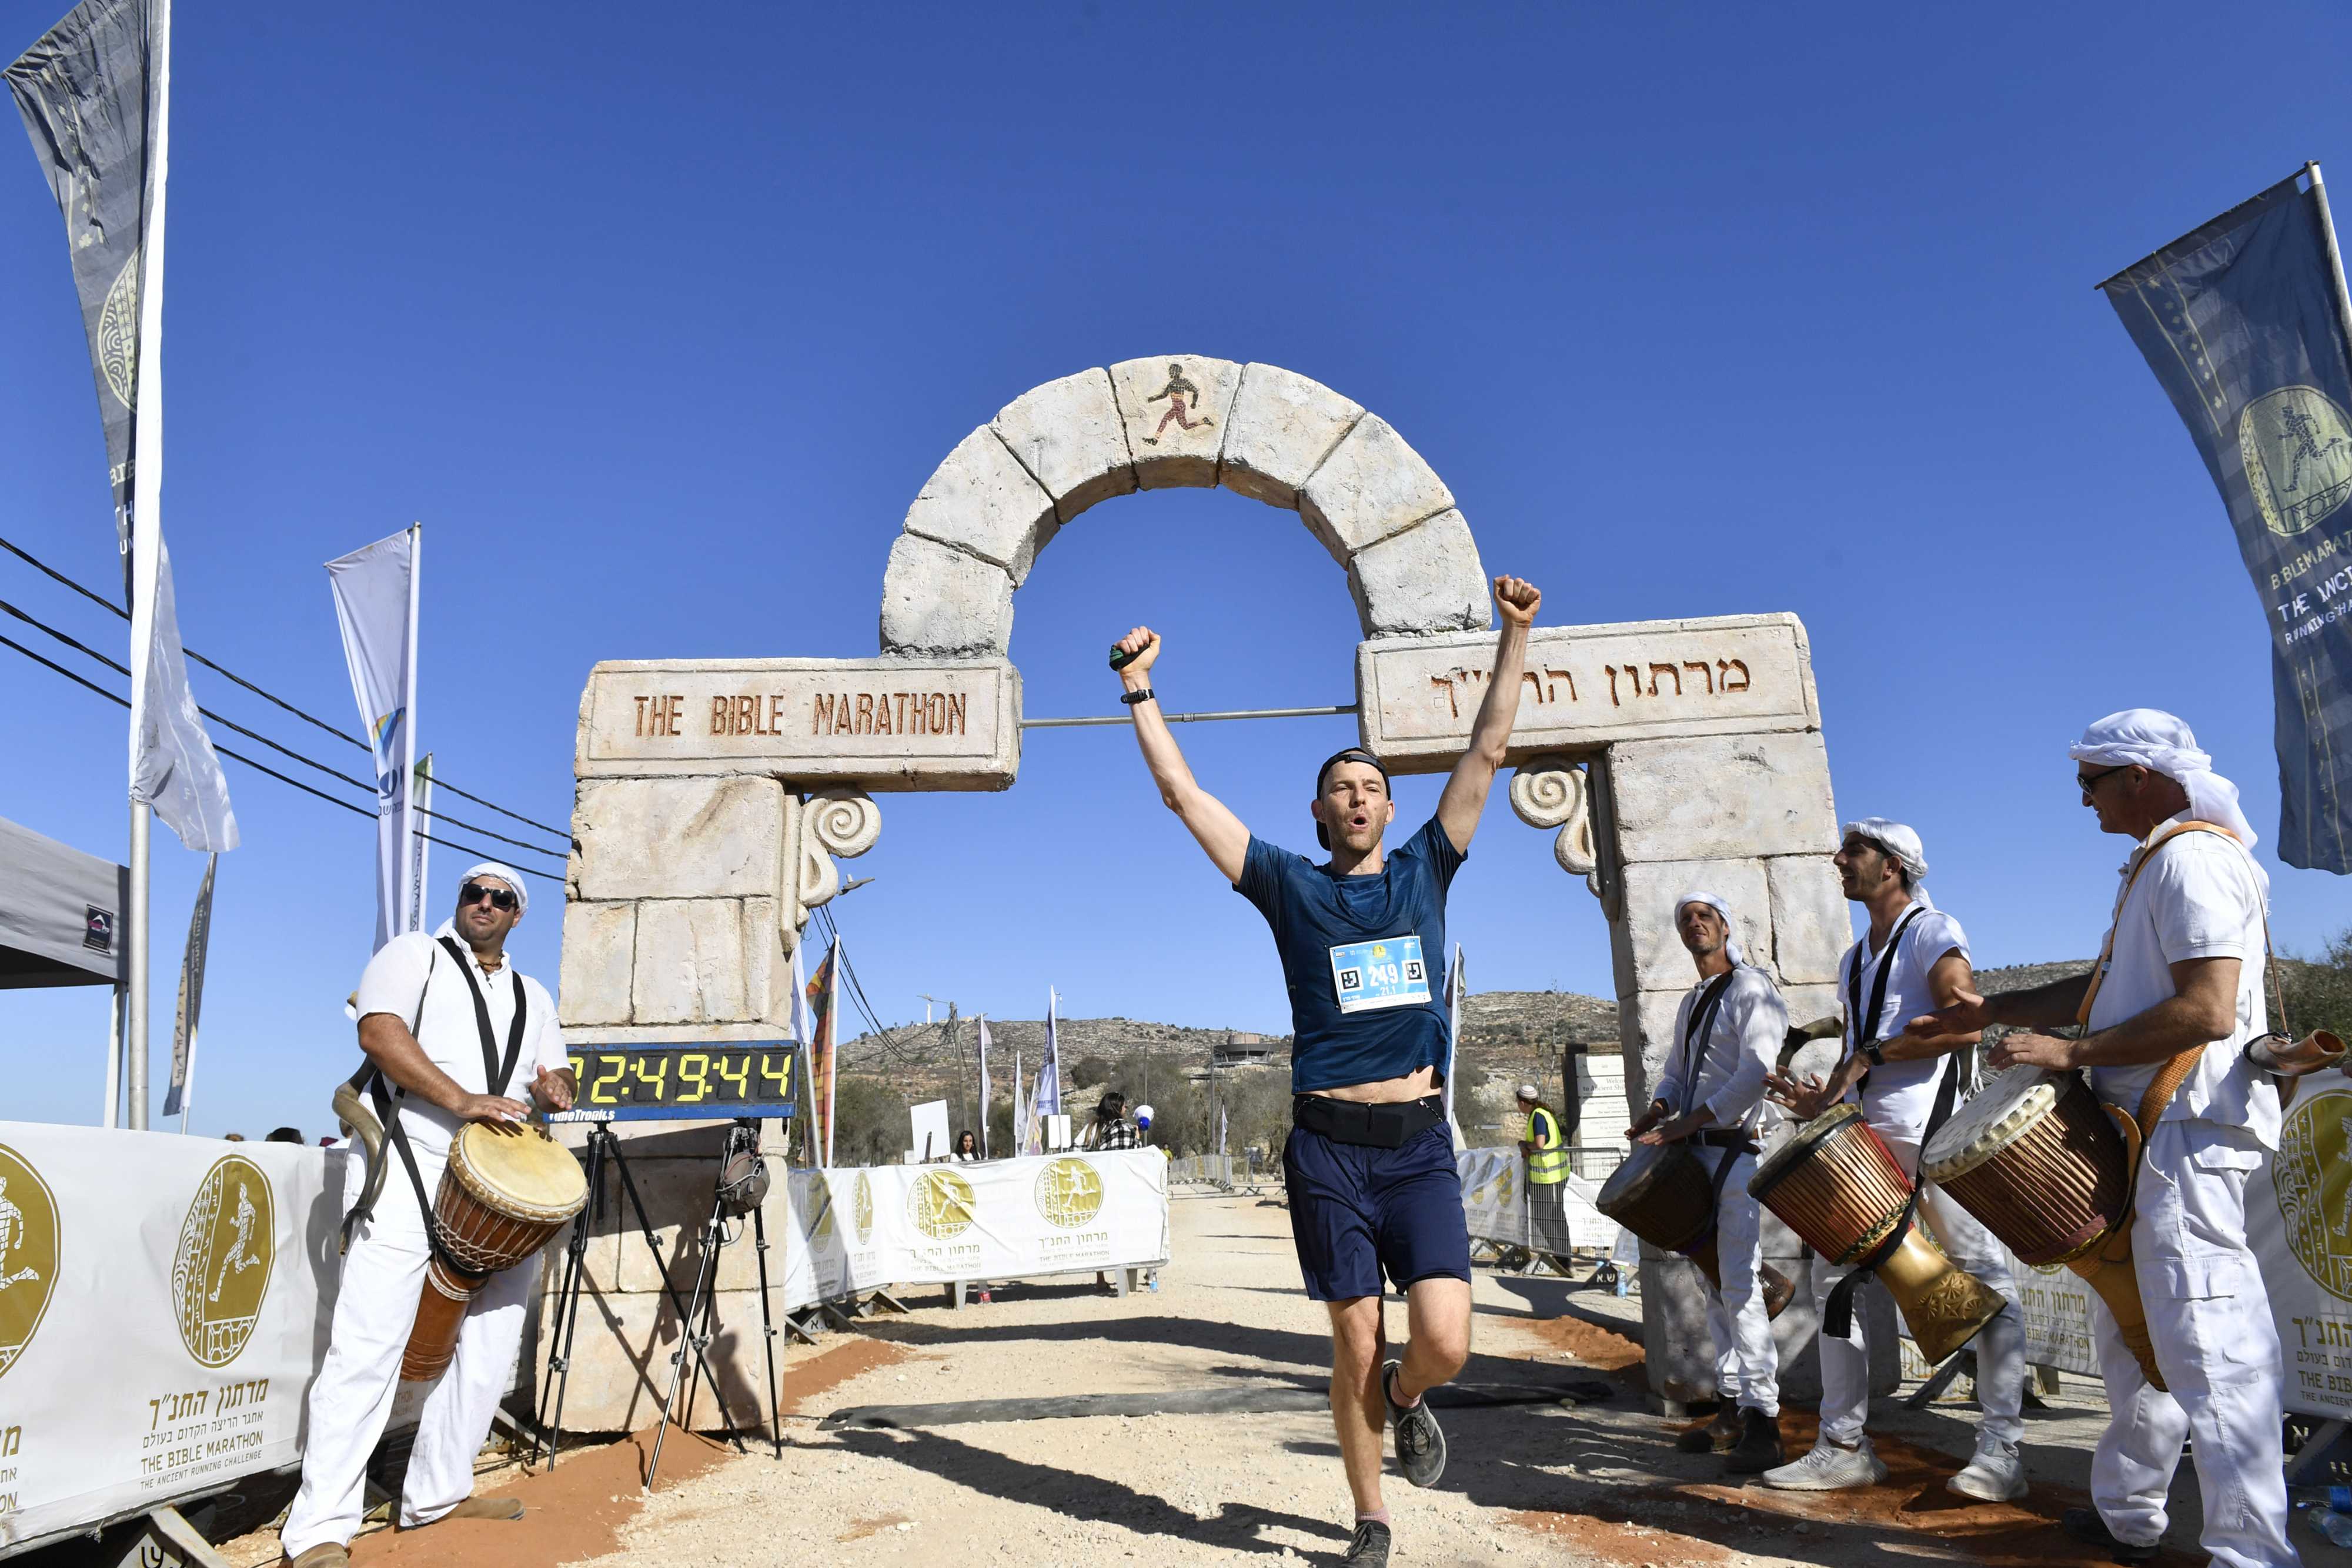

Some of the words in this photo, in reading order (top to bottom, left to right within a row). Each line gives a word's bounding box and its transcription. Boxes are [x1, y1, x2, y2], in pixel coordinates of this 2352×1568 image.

[1431, 663, 1577, 719] הת"ך
[1605, 658, 1750, 706] מרתון
[634, 695, 684, 737] THE
[710, 695, 784, 737] BIBLE
[812, 692, 967, 736] MARATHON
[1368, 964, 1399, 987] 249
[1380, 985, 1396, 996] 21.1
[1038, 1236, 1070, 1249] התנ"ך
[1076, 1232, 1108, 1245] מרתון
[948, 1244, 980, 1257] מרתון
[2050, 1290, 2086, 1315] מרתון
[2027, 1328, 2047, 1342] BIBLE
[2048, 1331, 2090, 1350] MARATHON
[2297, 1349, 2328, 1366] בעולם
[2298, 1370, 2324, 1389] THE
[216, 1378, 269, 1417] מרתון
[2300, 1390, 2316, 1402] THE
[149, 1390, 209, 1430] התנ"ך
[242, 1410, 263, 1426] אתגר
[178, 1423, 206, 1440] הקדום
[211, 1417, 238, 1433] הריצה
[143, 1431, 172, 1449] בעולם
[141, 1454, 162, 1475] THE
[168, 1445, 202, 1468] BIBLE
[206, 1430, 263, 1457] MARATHON
[141, 1479, 153, 1491] THE
[157, 1469, 188, 1486] ANCIENT
[191, 1460, 221, 1476] RUNNING
[225, 1450, 262, 1467] CHALLENGE
